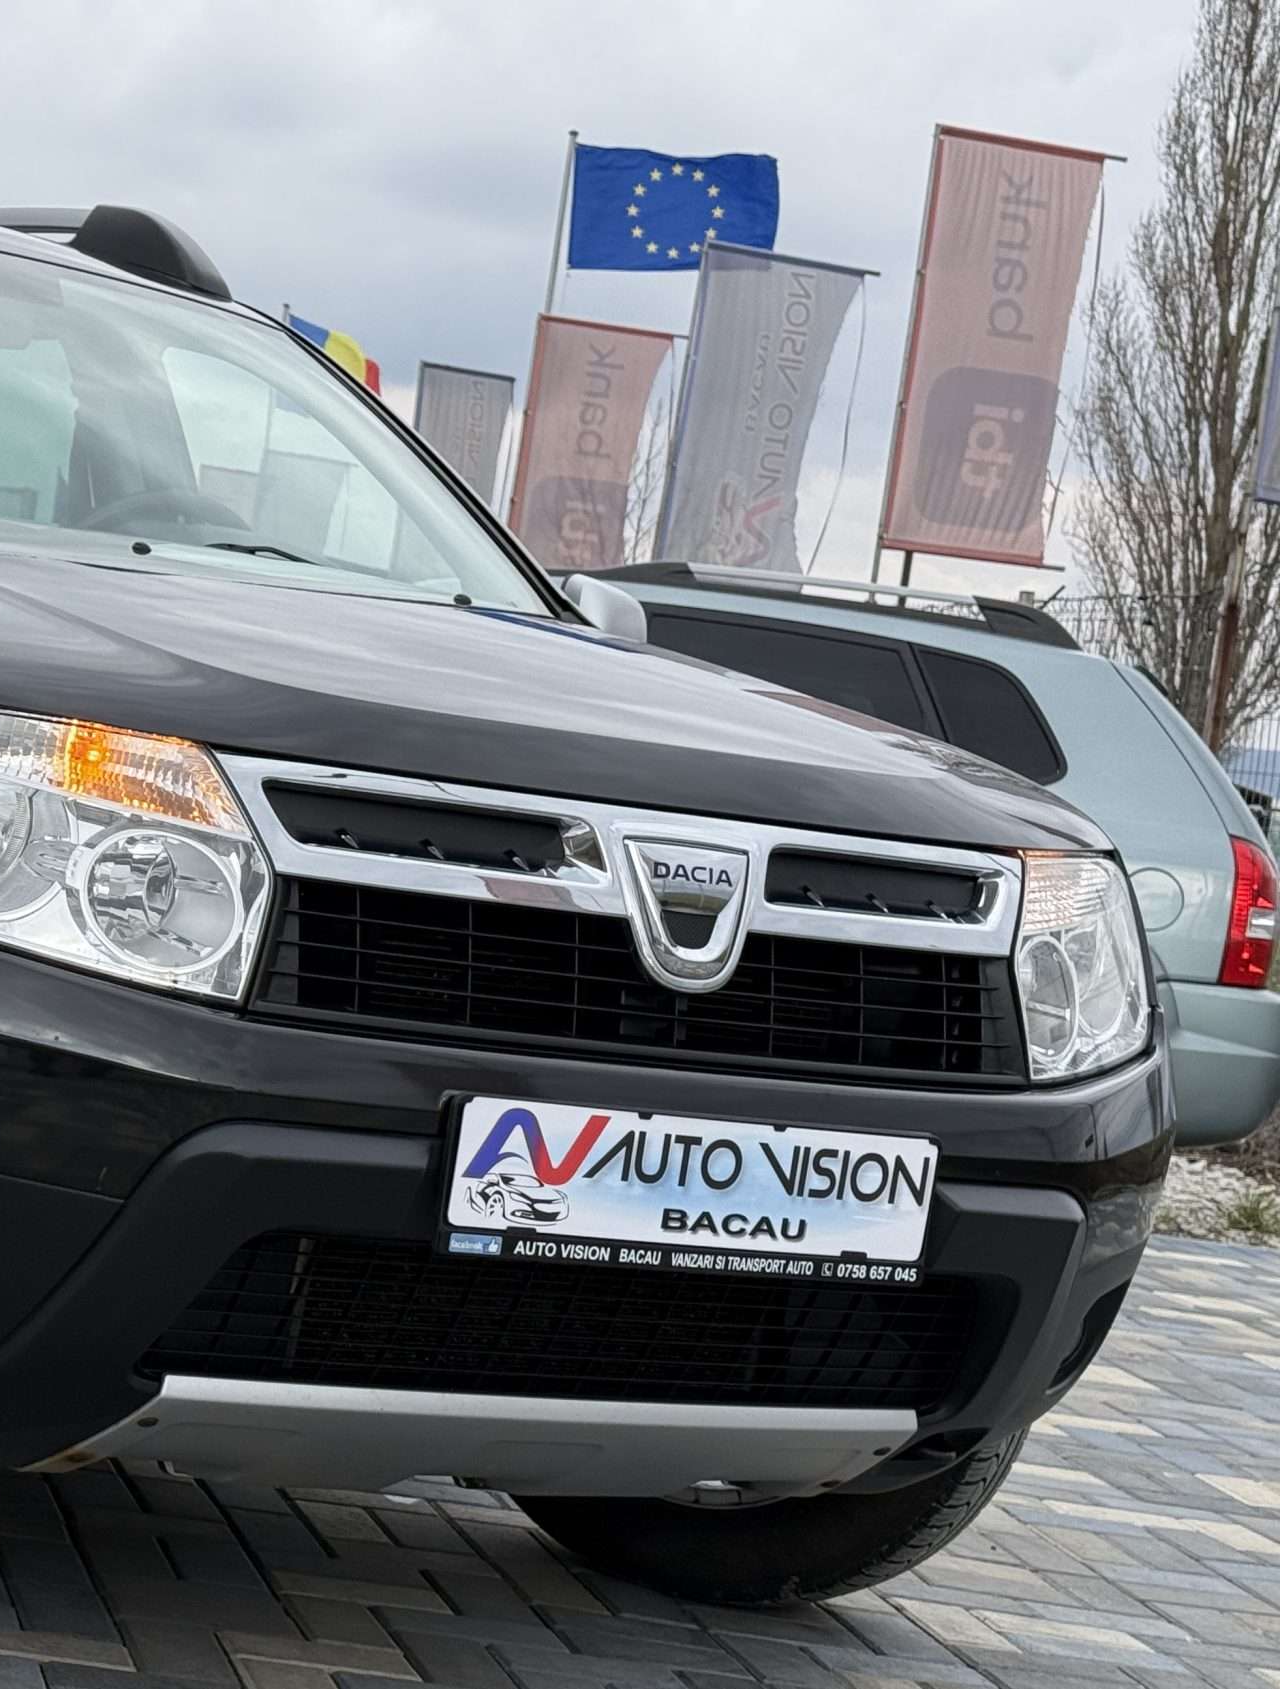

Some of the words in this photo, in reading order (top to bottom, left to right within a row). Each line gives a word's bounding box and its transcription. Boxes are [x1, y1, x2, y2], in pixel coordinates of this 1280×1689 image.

[652, 861, 734, 888] DACIA
[582, 1129, 744, 1190] AUTO
[759, 1141, 931, 1207] VISION
[659, 1207, 808, 1241] BACAU
[514, 1240, 557, 1258] AUTO
[561, 1243, 611, 1262] VISION
[619, 1248, 662, 1265] BACAU
[671, 1252, 714, 1270] VANZARI
[716, 1255, 726, 1270] SI
[727, 1255, 786, 1274] TRANSPORT
[786, 1260, 815, 1276] AUTO
[836, 1263, 868, 1280] 0758
[869, 1265, 893, 1281] 657
[894, 1267, 918, 1283] 045
